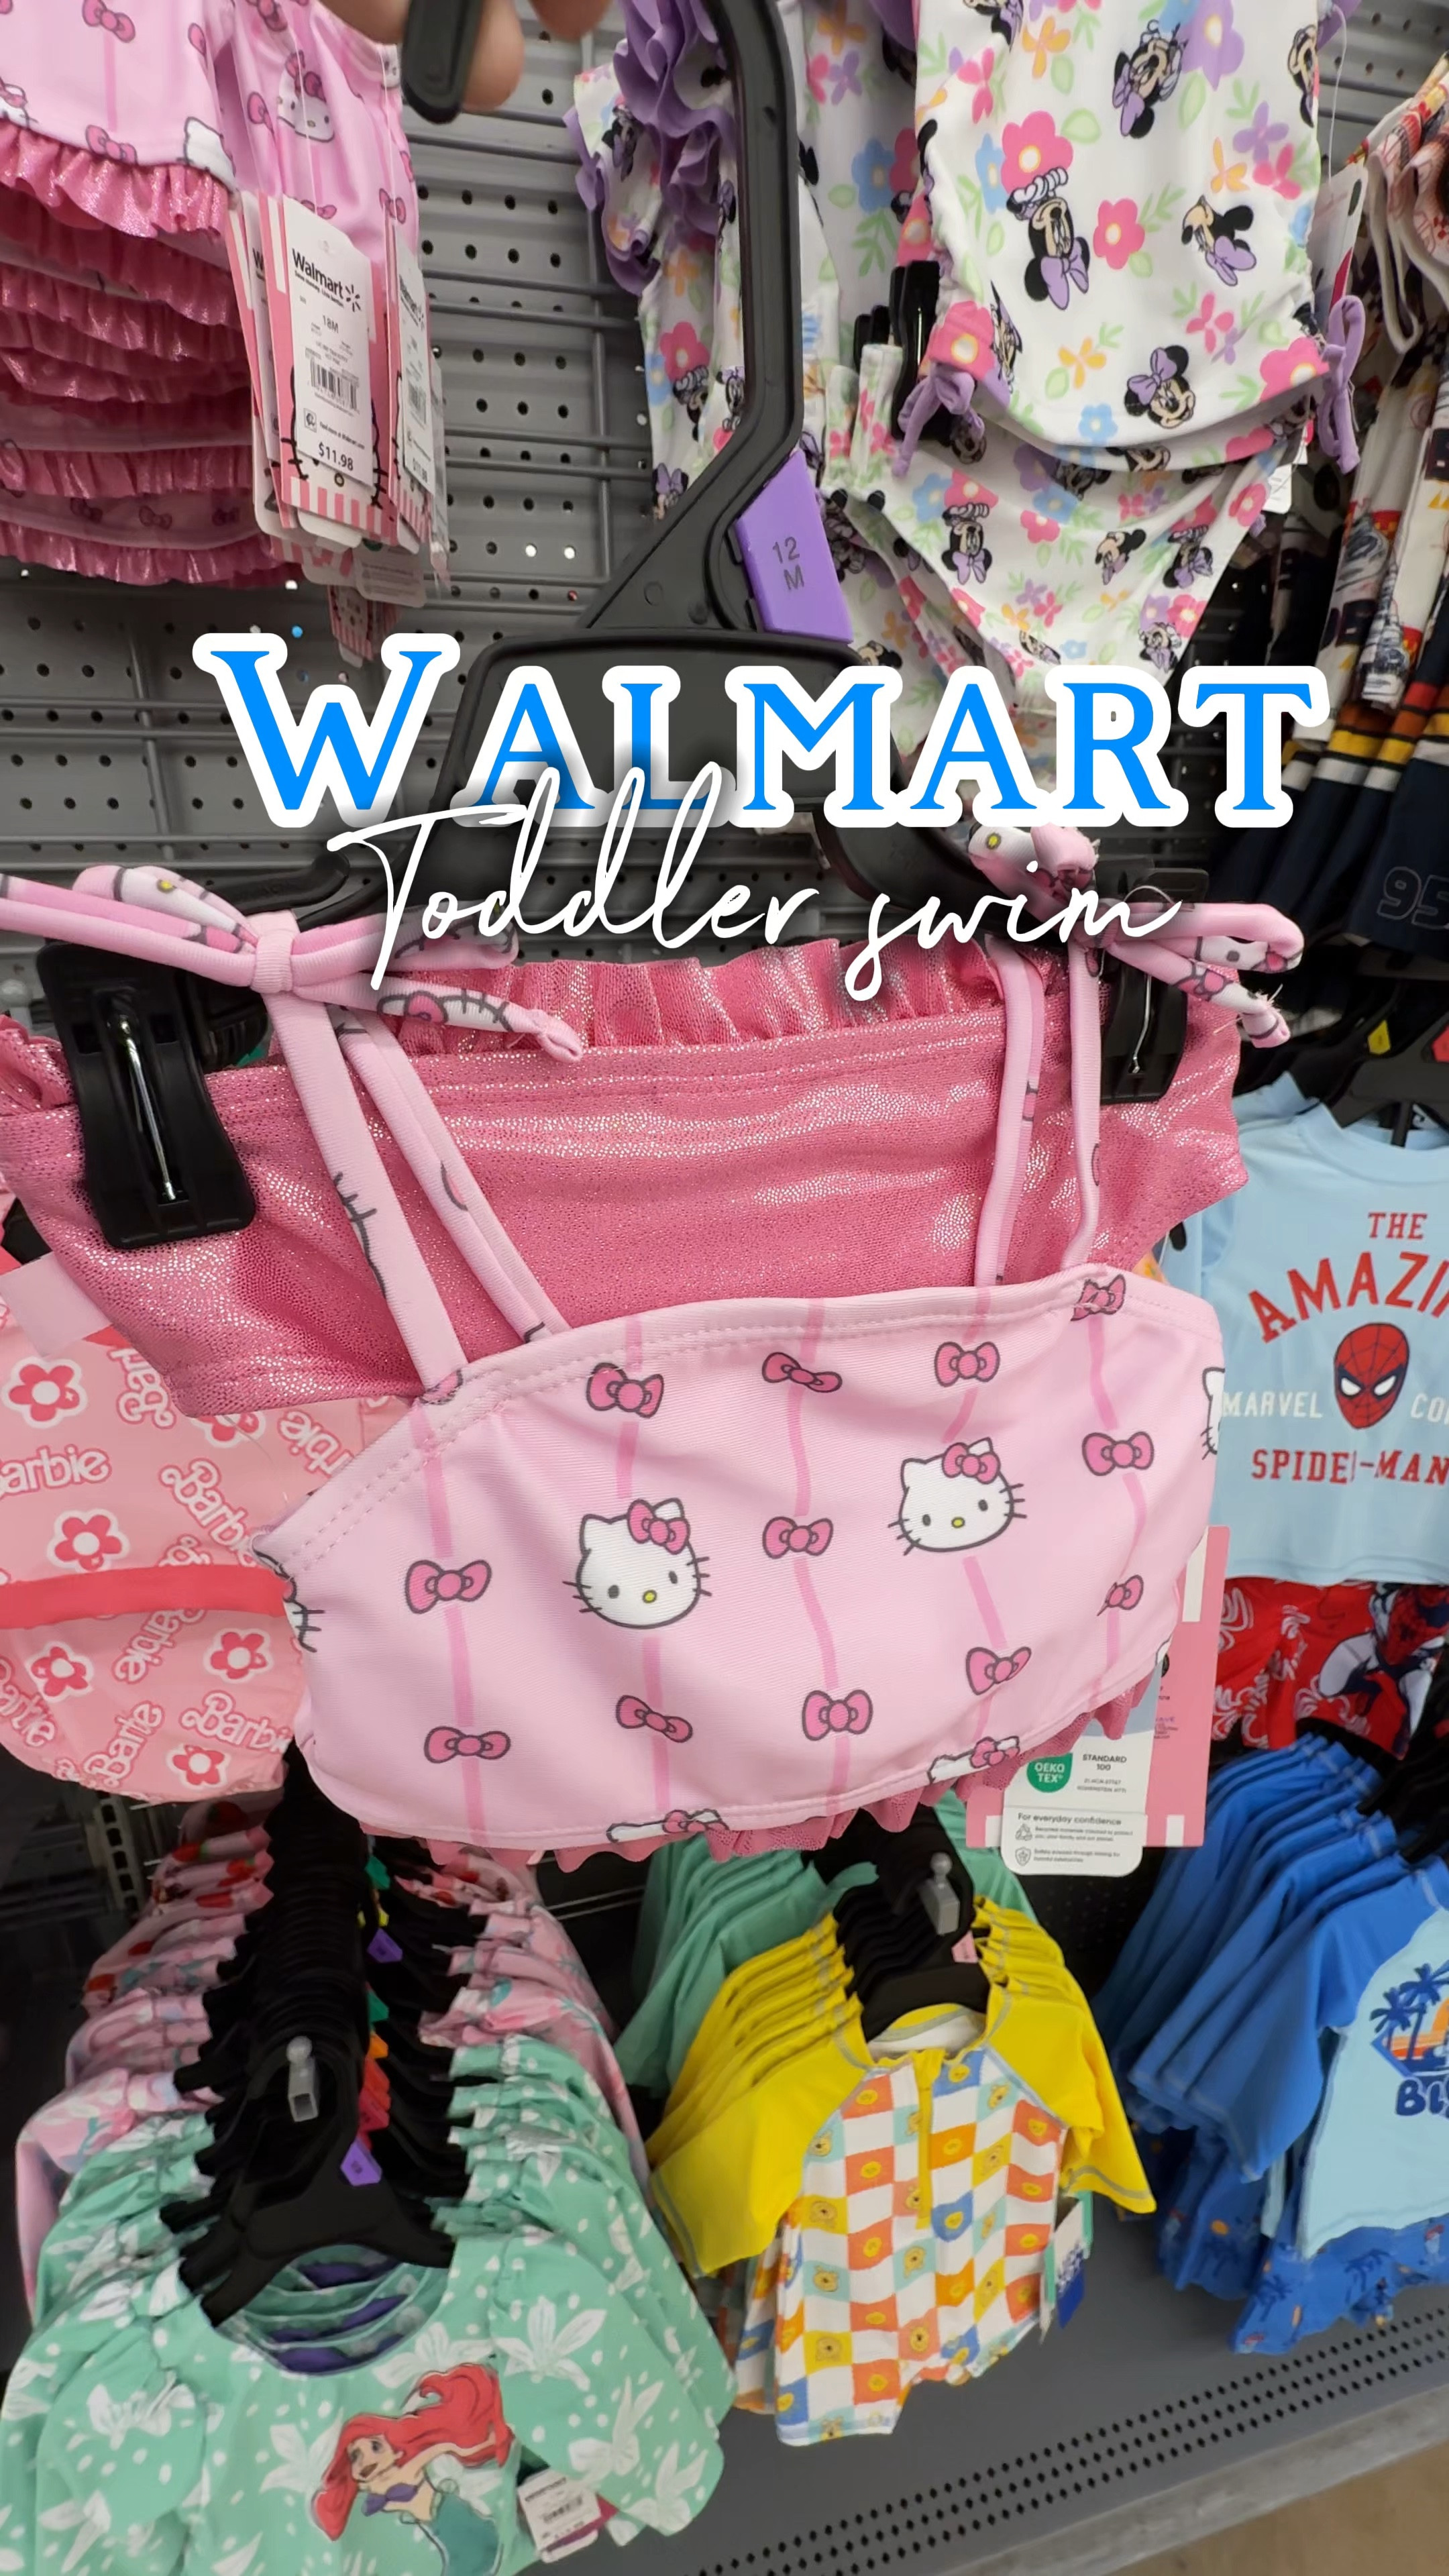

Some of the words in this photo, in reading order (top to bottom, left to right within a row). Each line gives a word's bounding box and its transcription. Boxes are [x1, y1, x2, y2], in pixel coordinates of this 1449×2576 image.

[292, 248, 343, 300] Walmart
[322, 315, 339, 334] 18M
[319, 441, 354, 471] $11.98
[772, 536, 800, 564] 12
[783, 564, 804, 591] M
[1368, 1212, 1428, 1240] THE
[1222, 1391, 1324, 1419] MARVEL
[1411, 1393, 1449, 1425] CO
[0, 1444, 113, 1500] arbie
[1250, 1448, 1449, 1486] SPIDE-MAN
[1034, 1762, 1066, 1773] OEKO
[1082, 1753, 1128, 1764] STANDARD
[1096, 1763, 1112, 1772] 100
[1018, 1812, 1031, 1820] For
[1033, 1815, 1073, 1824] everyday
[1074, 1815, 1122, 1826] confidence
[1395, 2078, 1449, 2121] BL
